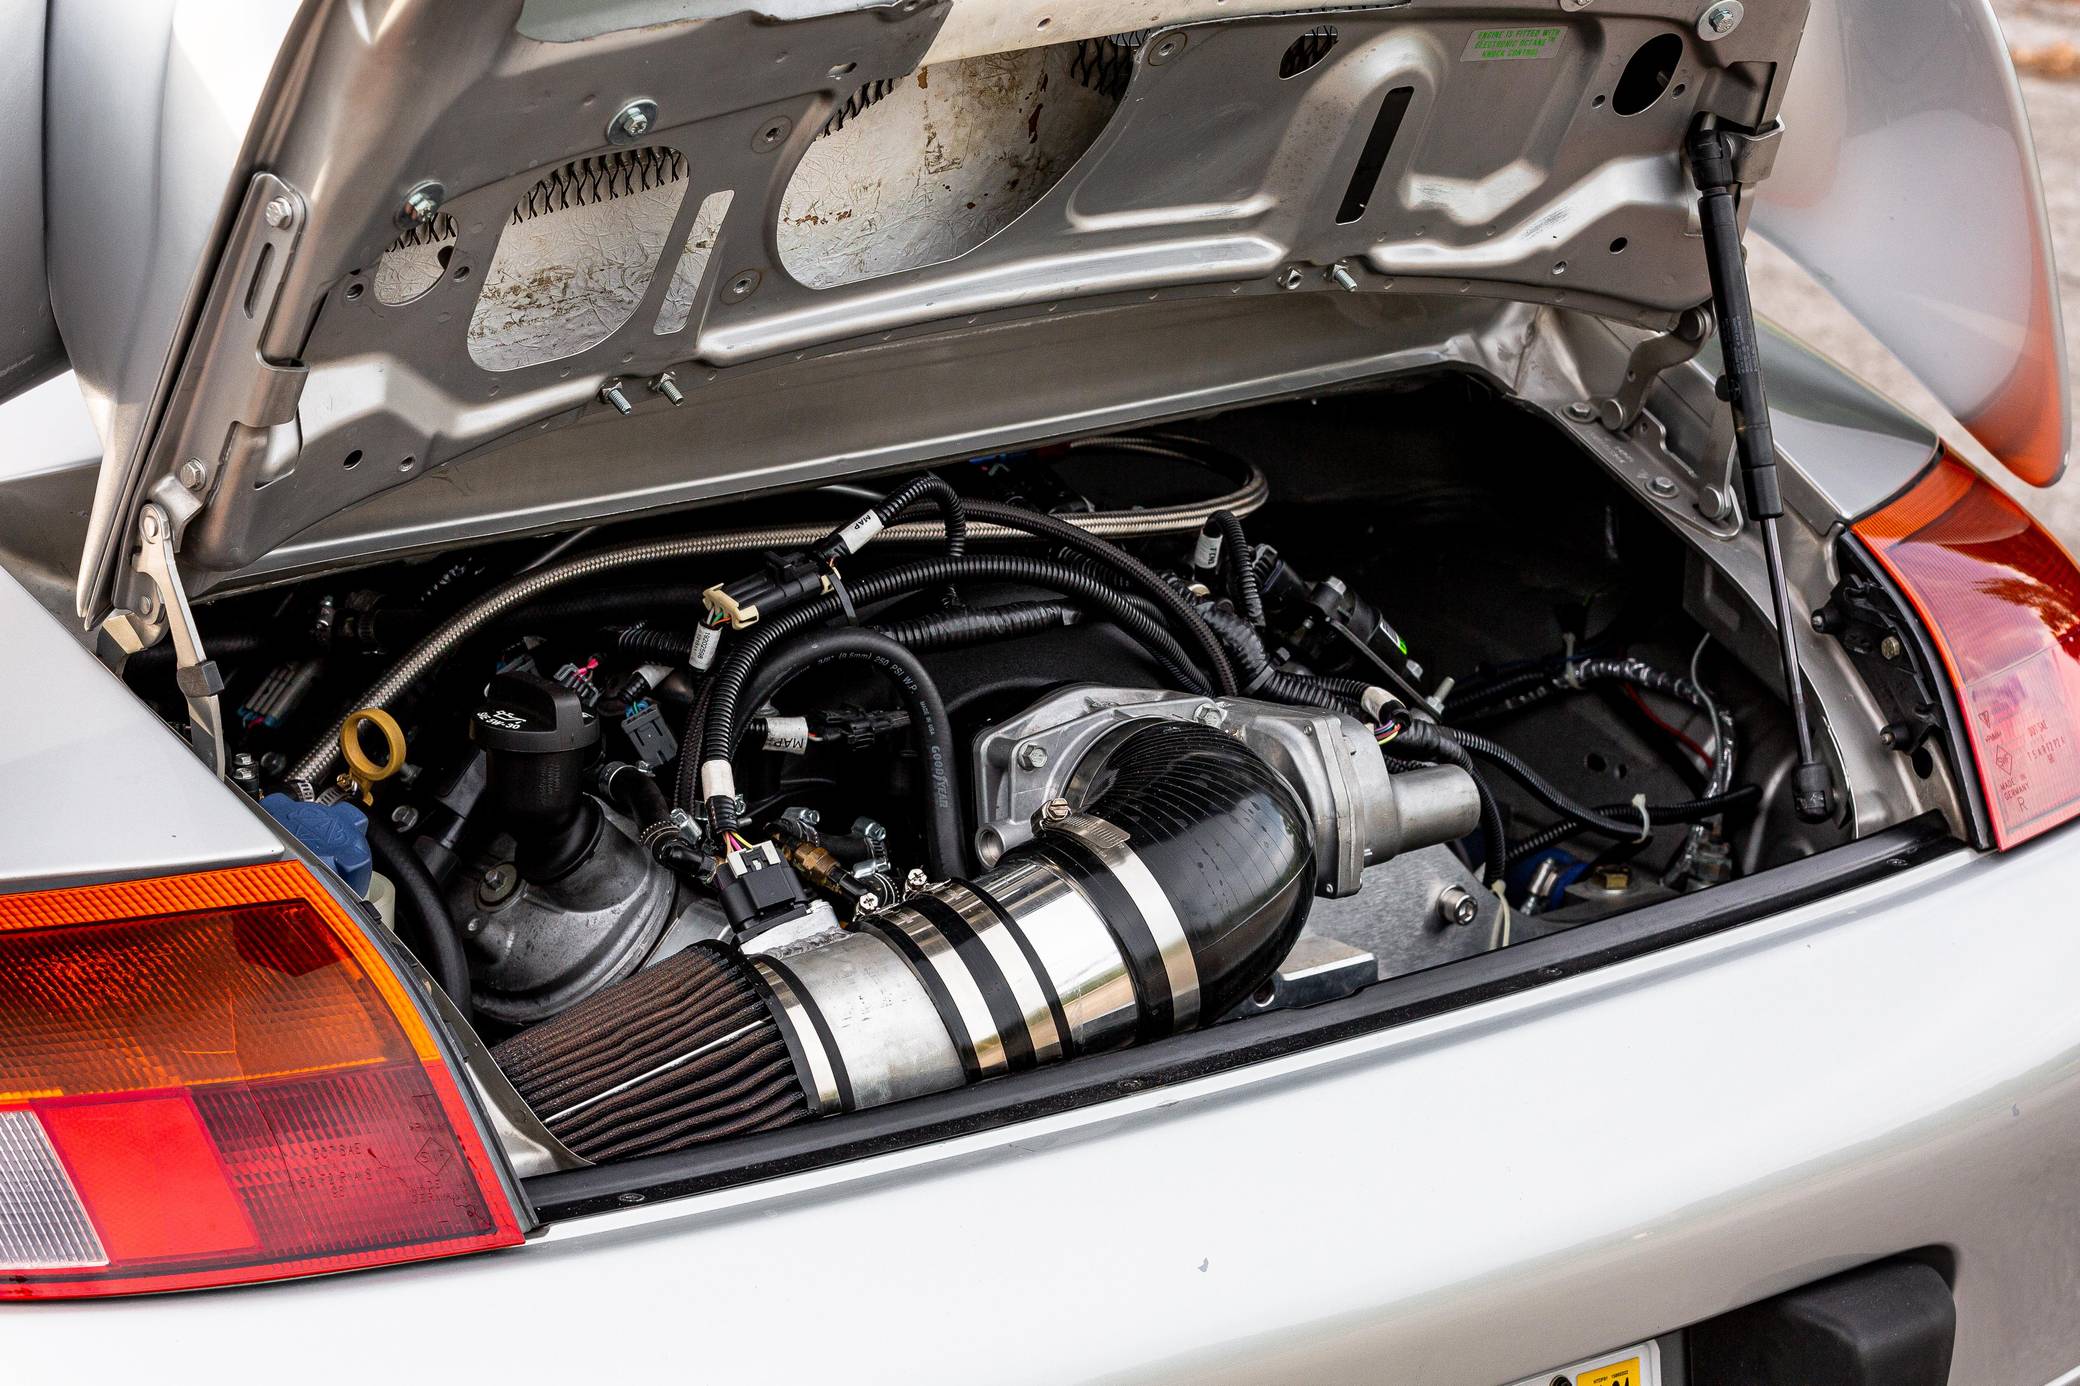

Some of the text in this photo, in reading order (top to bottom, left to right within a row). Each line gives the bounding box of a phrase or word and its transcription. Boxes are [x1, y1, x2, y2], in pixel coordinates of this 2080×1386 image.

[1477, 28, 1561, 40] ENGINE IS FITTED WITH
[1474, 39, 1516, 49] ELECTRONIC
[853, 513, 872, 531] MAP
[875, 655, 889, 666] 250
[890, 664, 904, 678] PSI
[927, 723, 936, 736] USA
[773, 737, 804, 749] MAP
[931, 745, 949, 809] GOODYEAR
[2000, 777, 2016, 792] MADE
[2003, 781, 2030, 801] GERMANY
[2017, 796, 2028, 813] R
